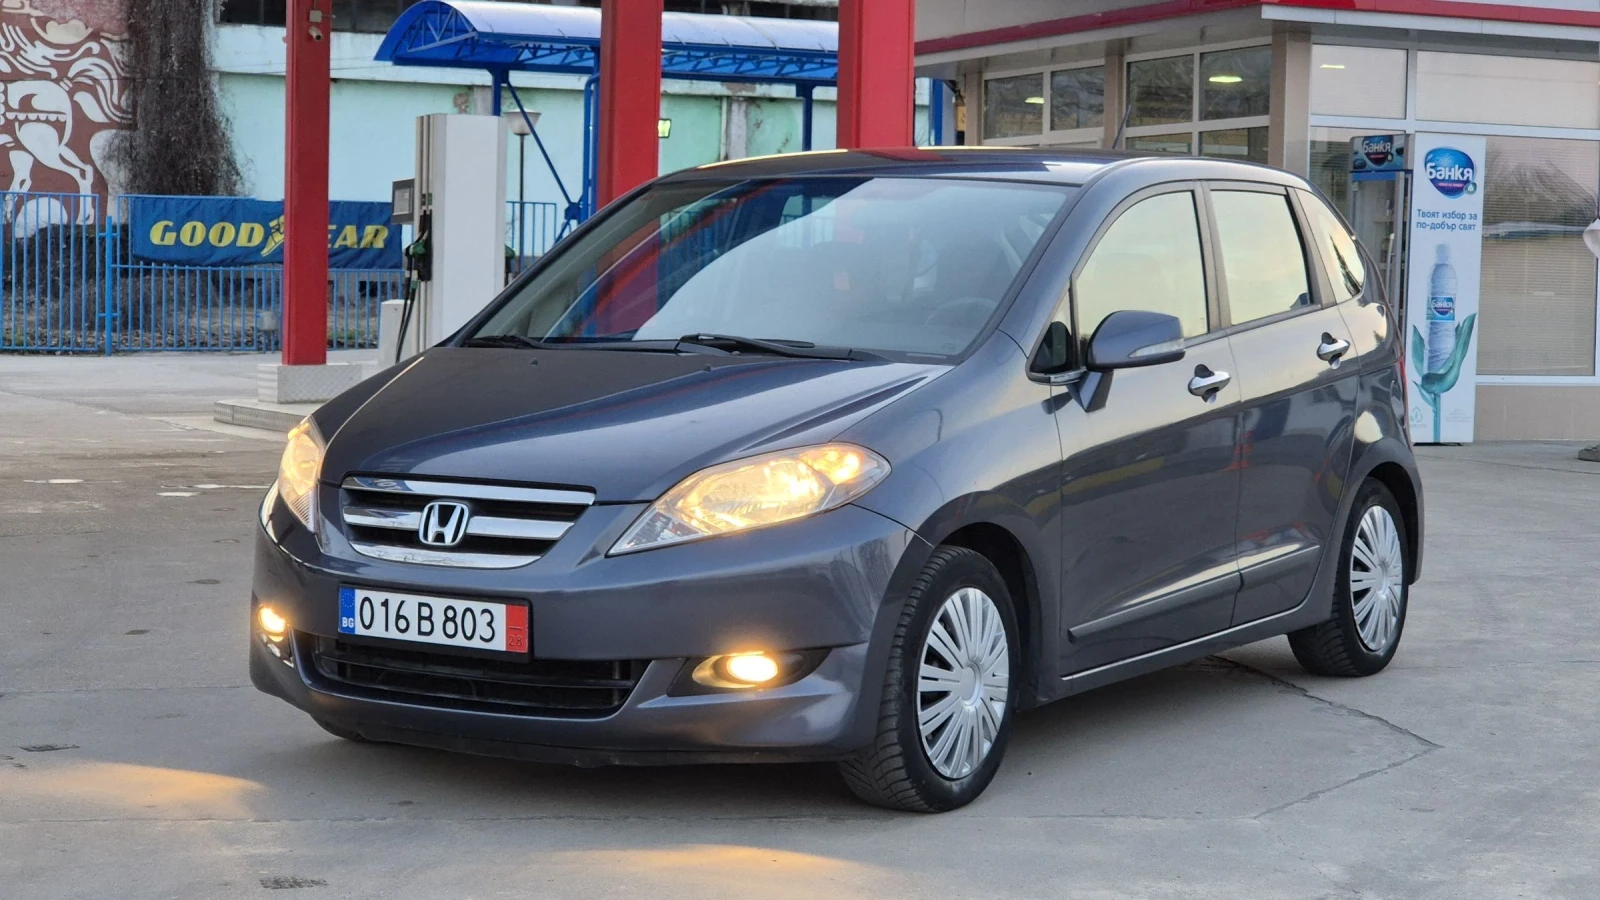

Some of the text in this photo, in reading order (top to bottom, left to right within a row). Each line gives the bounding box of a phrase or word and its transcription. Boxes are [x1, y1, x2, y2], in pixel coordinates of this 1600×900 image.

[1417, 209, 1478, 221] Твоят избор за
[1416, 221, 1457, 232] по-добър
[342, 617, 355, 629] BG
[508, 635, 523, 647] 28
